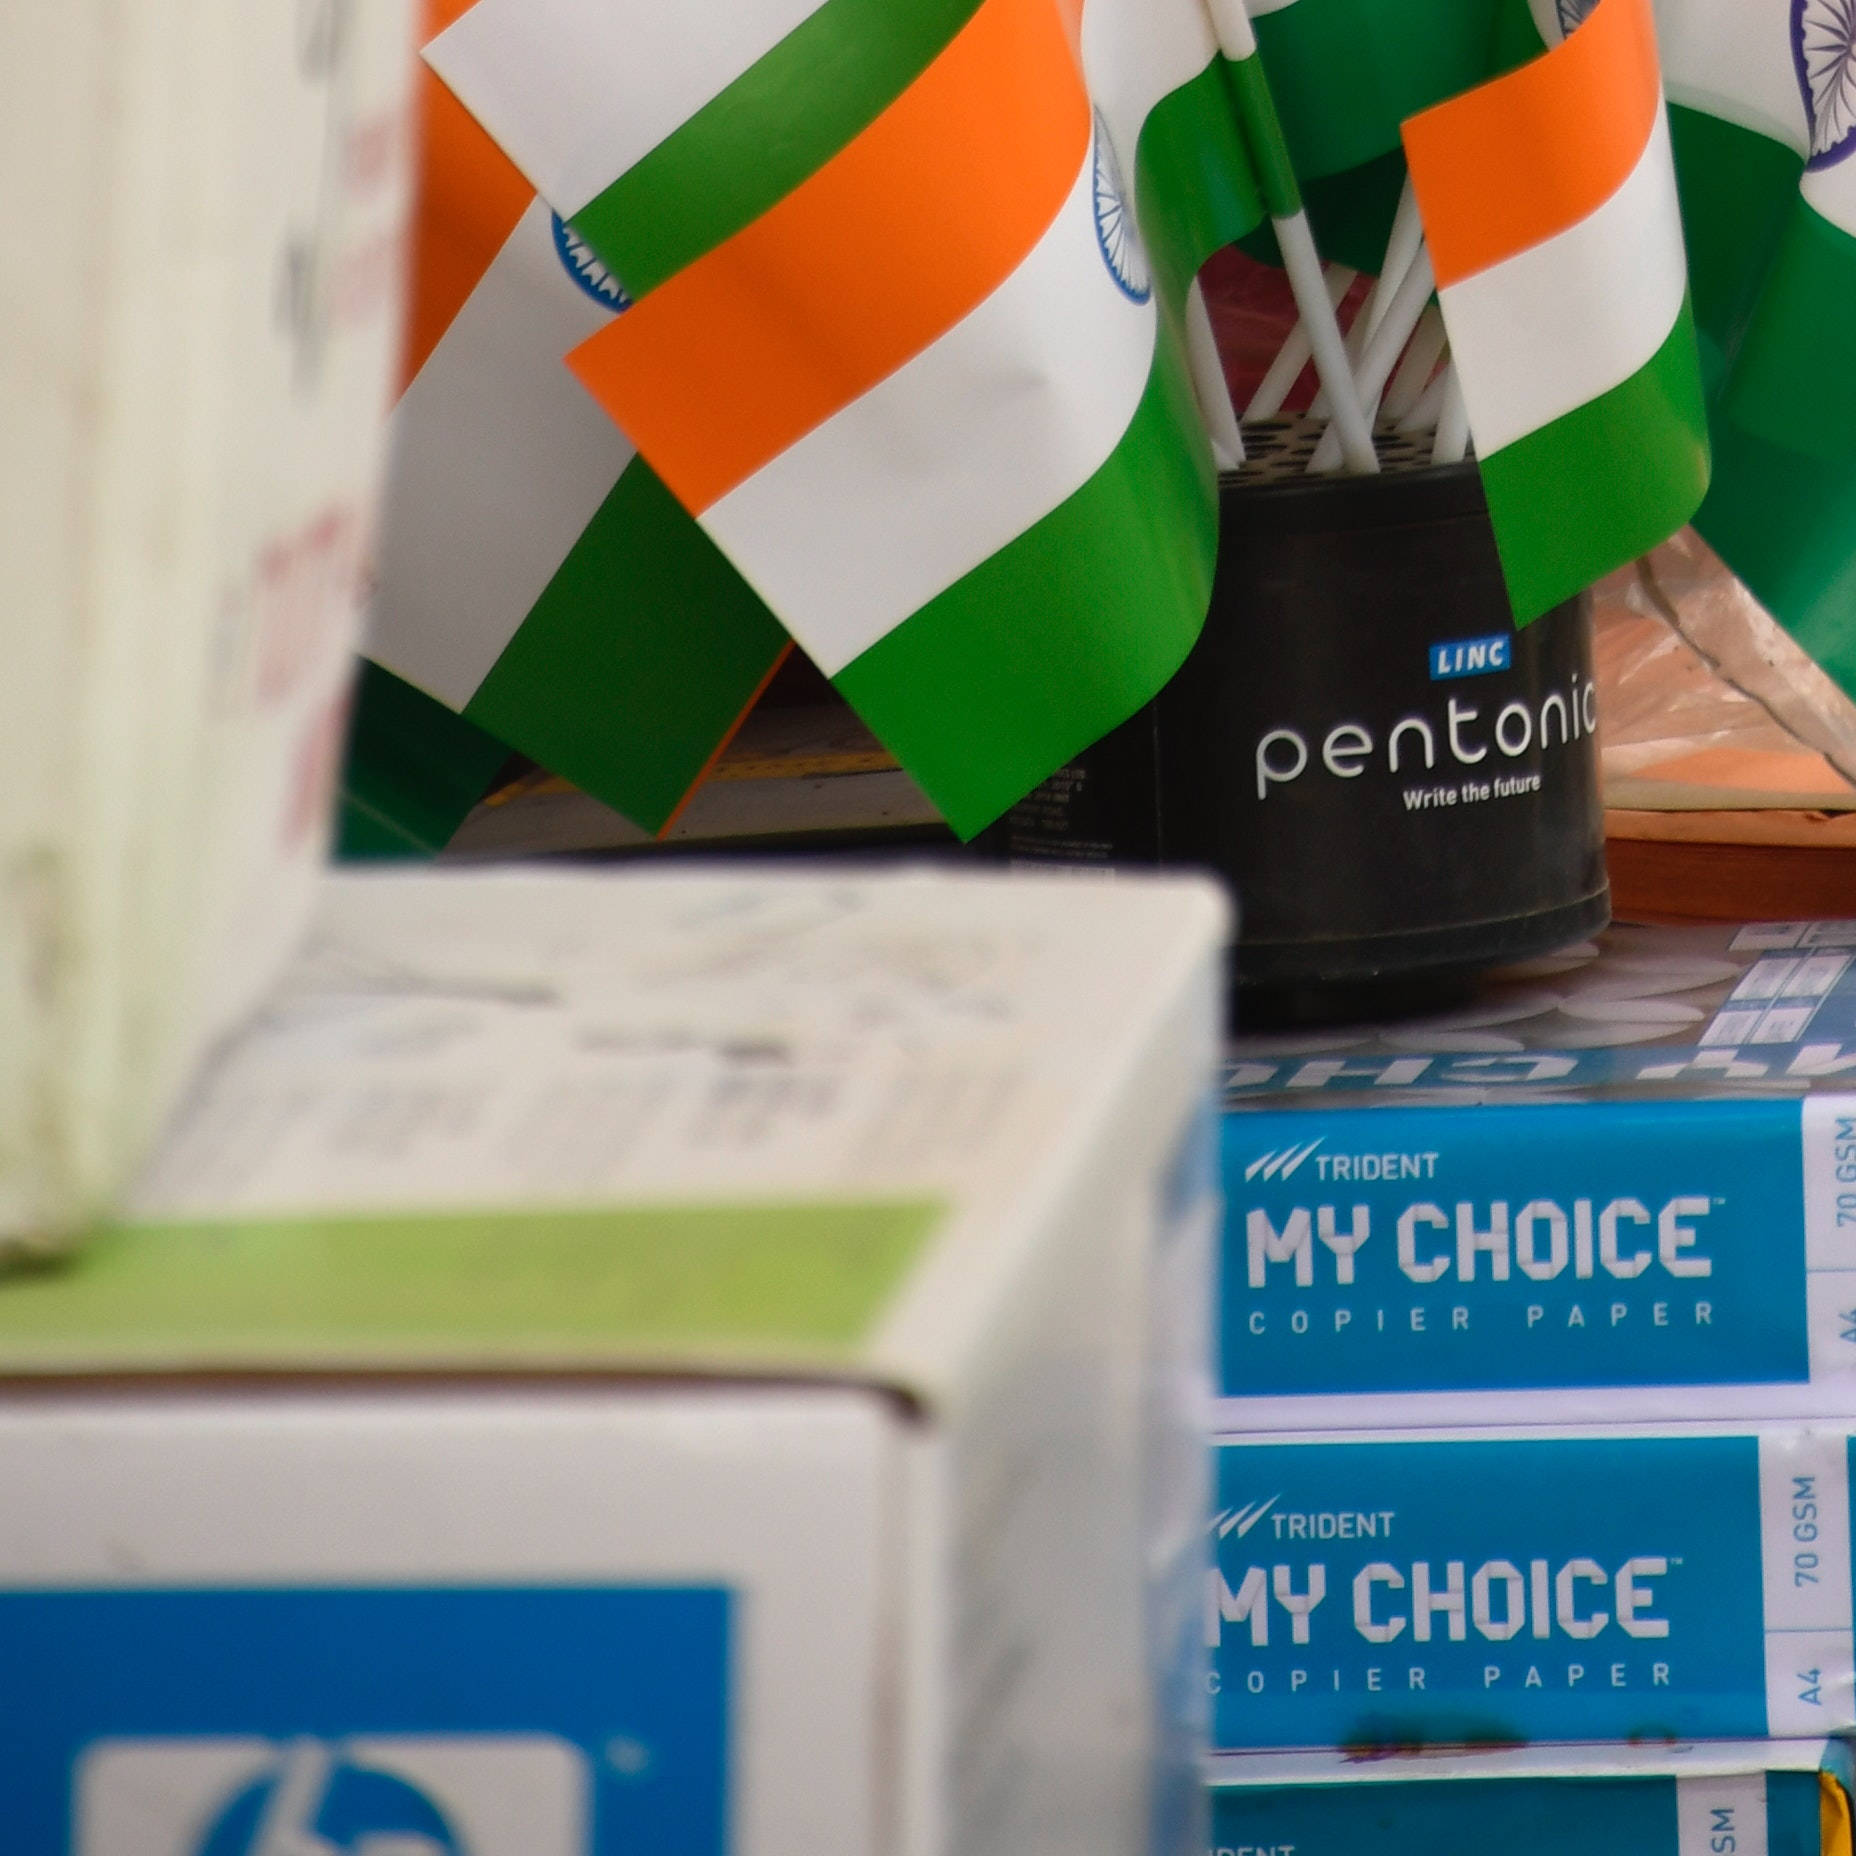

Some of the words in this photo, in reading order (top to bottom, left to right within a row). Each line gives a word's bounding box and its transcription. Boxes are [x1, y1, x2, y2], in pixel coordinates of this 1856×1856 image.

[1437, 640, 1504, 674] LINC
[1256, 672, 1597, 801] pentonic
[1403, 787, 1458, 811] Write
[1462, 779, 1490, 804] the
[1494, 773, 1542, 799] future
[1316, 1152, 1440, 1181] TRIDENT
[1245, 1204, 1371, 1288] MY
[1249, 1306, 1469, 1334] COPIER
[1527, 1301, 1714, 1329] PAPER
[1271, 1511, 1396, 1540] TRIDENT
[1792, 1476, 1817, 1542] GSM
[1793, 1554, 1818, 1587] 70
[1204, 1563, 1327, 1648] MY
[1206, 1667, 1426, 1694] COPIER
[1484, 1662, 1672, 1689] PAPER
[1798, 1668, 1822, 1706] A4
